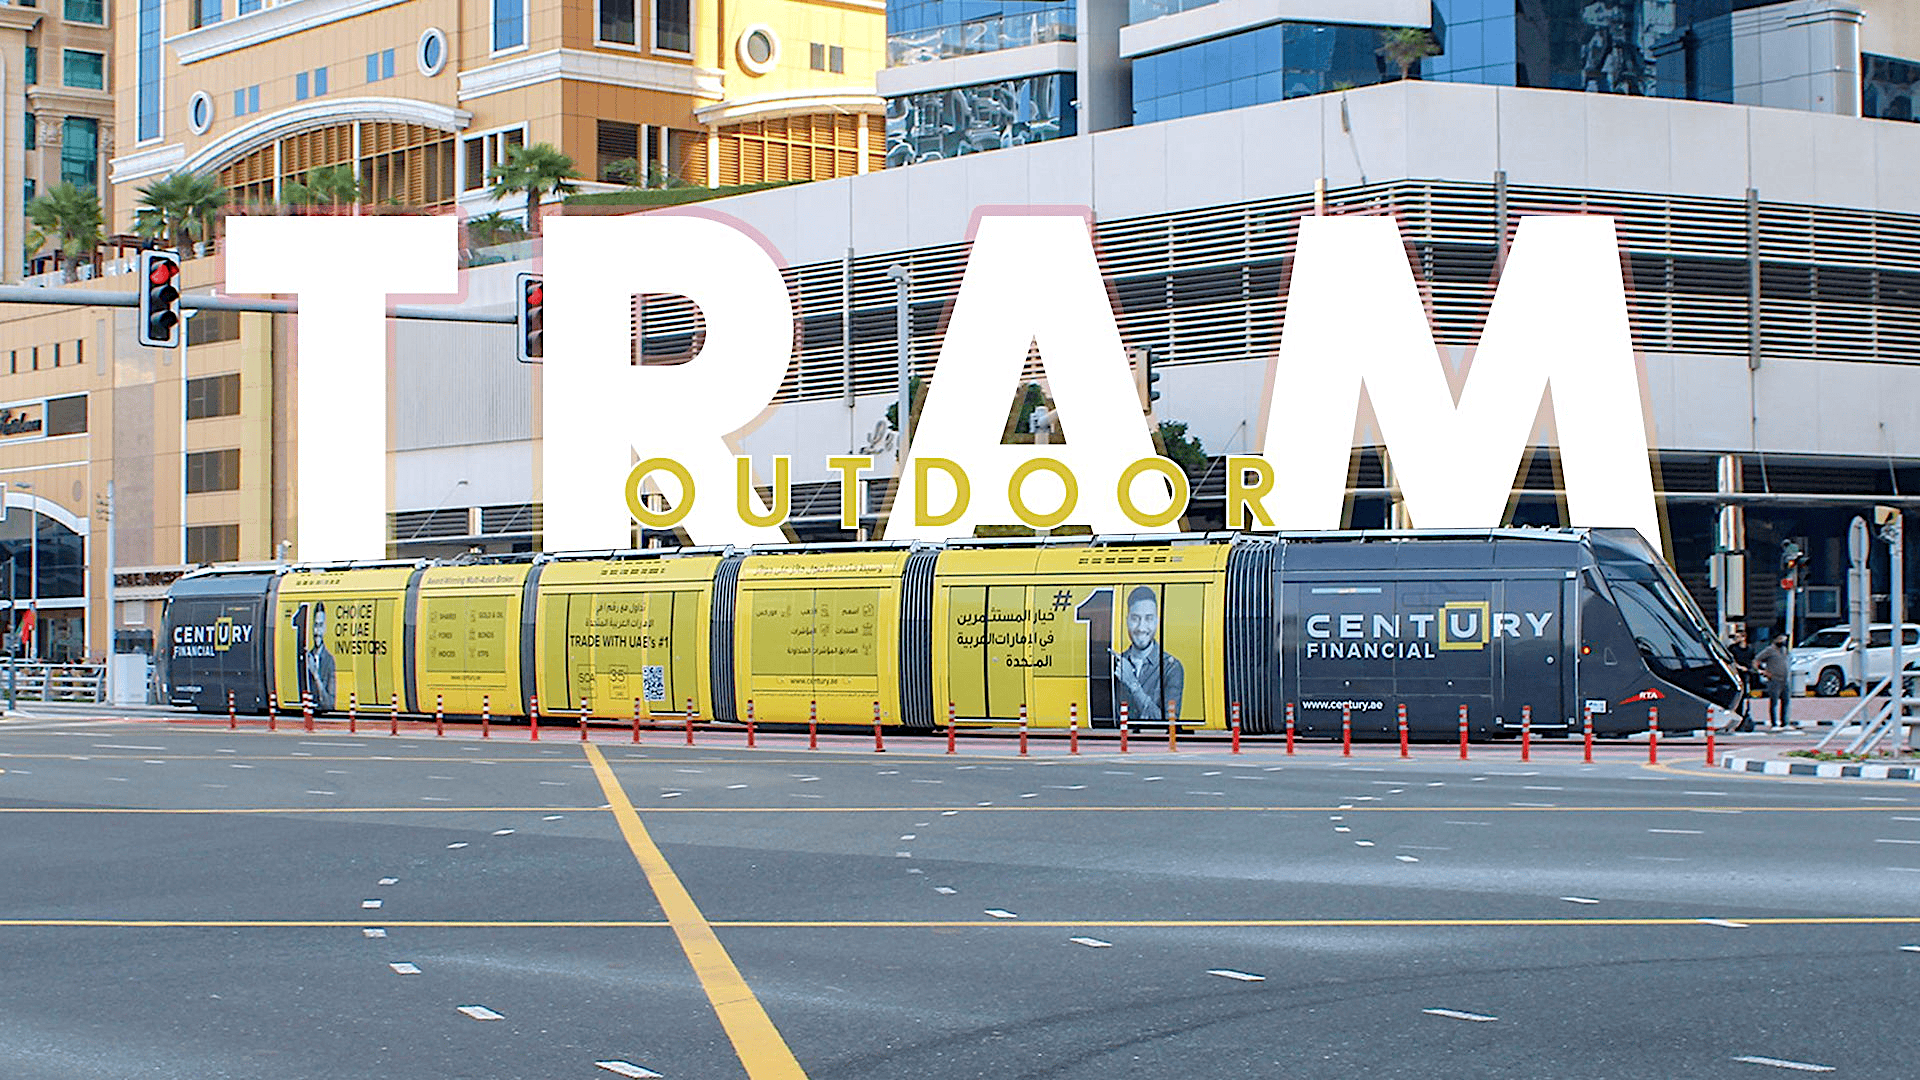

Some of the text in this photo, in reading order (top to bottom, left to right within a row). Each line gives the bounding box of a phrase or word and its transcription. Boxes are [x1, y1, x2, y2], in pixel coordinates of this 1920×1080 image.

[335, 604, 372, 619] CHOICE
[1033, 609, 1055, 625] خيار
[334, 622, 370, 637] OF UAE
[1306, 612, 1553, 639] CENTURY
[173, 623, 252, 644] CENTURY
[1039, 630, 1054, 651] في
[334, 640, 388, 655] INVESTORS
[570, 635, 600, 647] TRADE
[602, 634, 627, 647] WITH
[658, 635, 669, 649] #1
[173, 646, 216, 659] FINANCIAL
[1306, 642, 1436, 660] FINANCIAL
[1639, 691, 1658, 700] RTA
